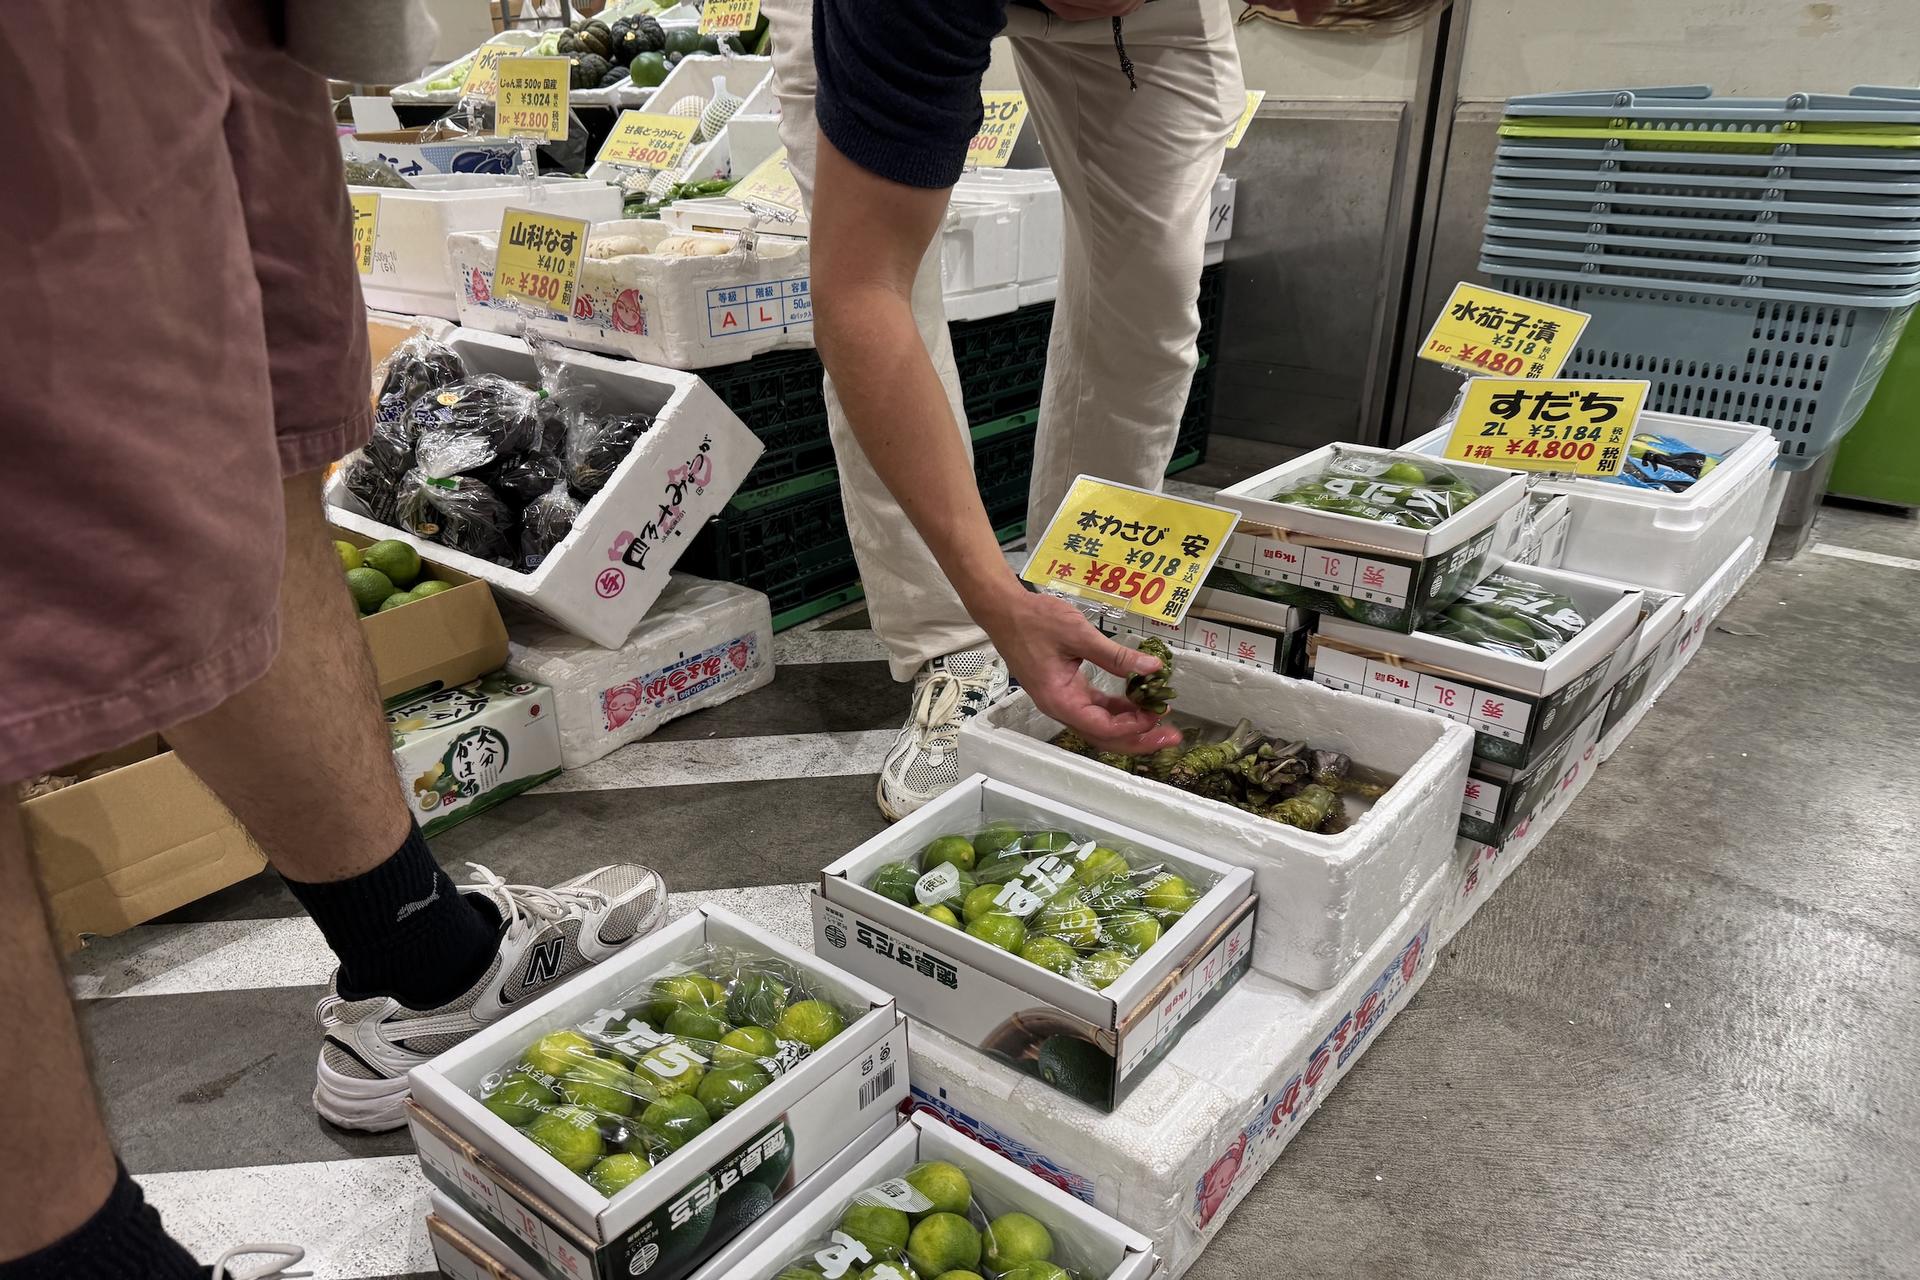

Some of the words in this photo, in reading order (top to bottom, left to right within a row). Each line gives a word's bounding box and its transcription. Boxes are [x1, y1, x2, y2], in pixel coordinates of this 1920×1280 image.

[716, 14, 743, 26] ¥850
[524, 79, 541, 90] 500g
[498, 113, 510, 125] 1pc
[624, 124, 686, 140] 甘長とうがらし
[628, 146, 668, 164] ¥800
[648, 139, 675, 150] ¥864
[508, 221, 578, 256] 山科なす
[537, 255, 566, 274] ¥410
[500, 272, 515, 286] 1pc
[518, 272, 560, 301] ¥380
[561, 280, 573, 306] 税別
[791, 281, 808, 293] 容量
[722, 311, 737, 327] A
[760, 306, 772, 321] L
[1451, 300, 1561, 344] 水茄子漬
[1492, 333, 1535, 356] ¥518
[1429, 340, 1452, 354] 1pc
[1458, 343, 1524, 377] ¥480
[1489, 389, 1625, 424] すだち
[1480, 422, 1508, 437] 2L
[1464, 444, 1493, 459] 1箱
[1597, 446, 1619, 472] 税別
[1076, 509, 1170, 547] 本わさび
[1181, 534, 1209, 558] 安
[1063, 533, 1103, 557] 実生
[1124, 547, 1181, 577] ¥918
[1263, 547, 1298, 564] 1kg詰
[1320, 555, 1341, 576] 3L
[1046, 559, 1076, 579] 1本
[1082, 560, 1166, 605] ¥850
[1182, 562, 1201, 584] 税込
[1362, 567, 1386, 588] 秀
[1162, 586, 1191, 617] 税別
[1200, 629, 1219, 649] 3L
[1236, 640, 1257, 660] 秀
[646, 655, 722, 701] みょうが
[1375, 671, 1410, 690] 1kg詰
[1434, 686, 1457, 708] 3L
[1481, 697, 1505, 720] 秀
[476, 727, 499, 768] 大分
[525, 937, 565, 986] N
[856, 930, 958, 990] 徳島すだち
[668, 1132, 786, 1230] 徳島すだち
